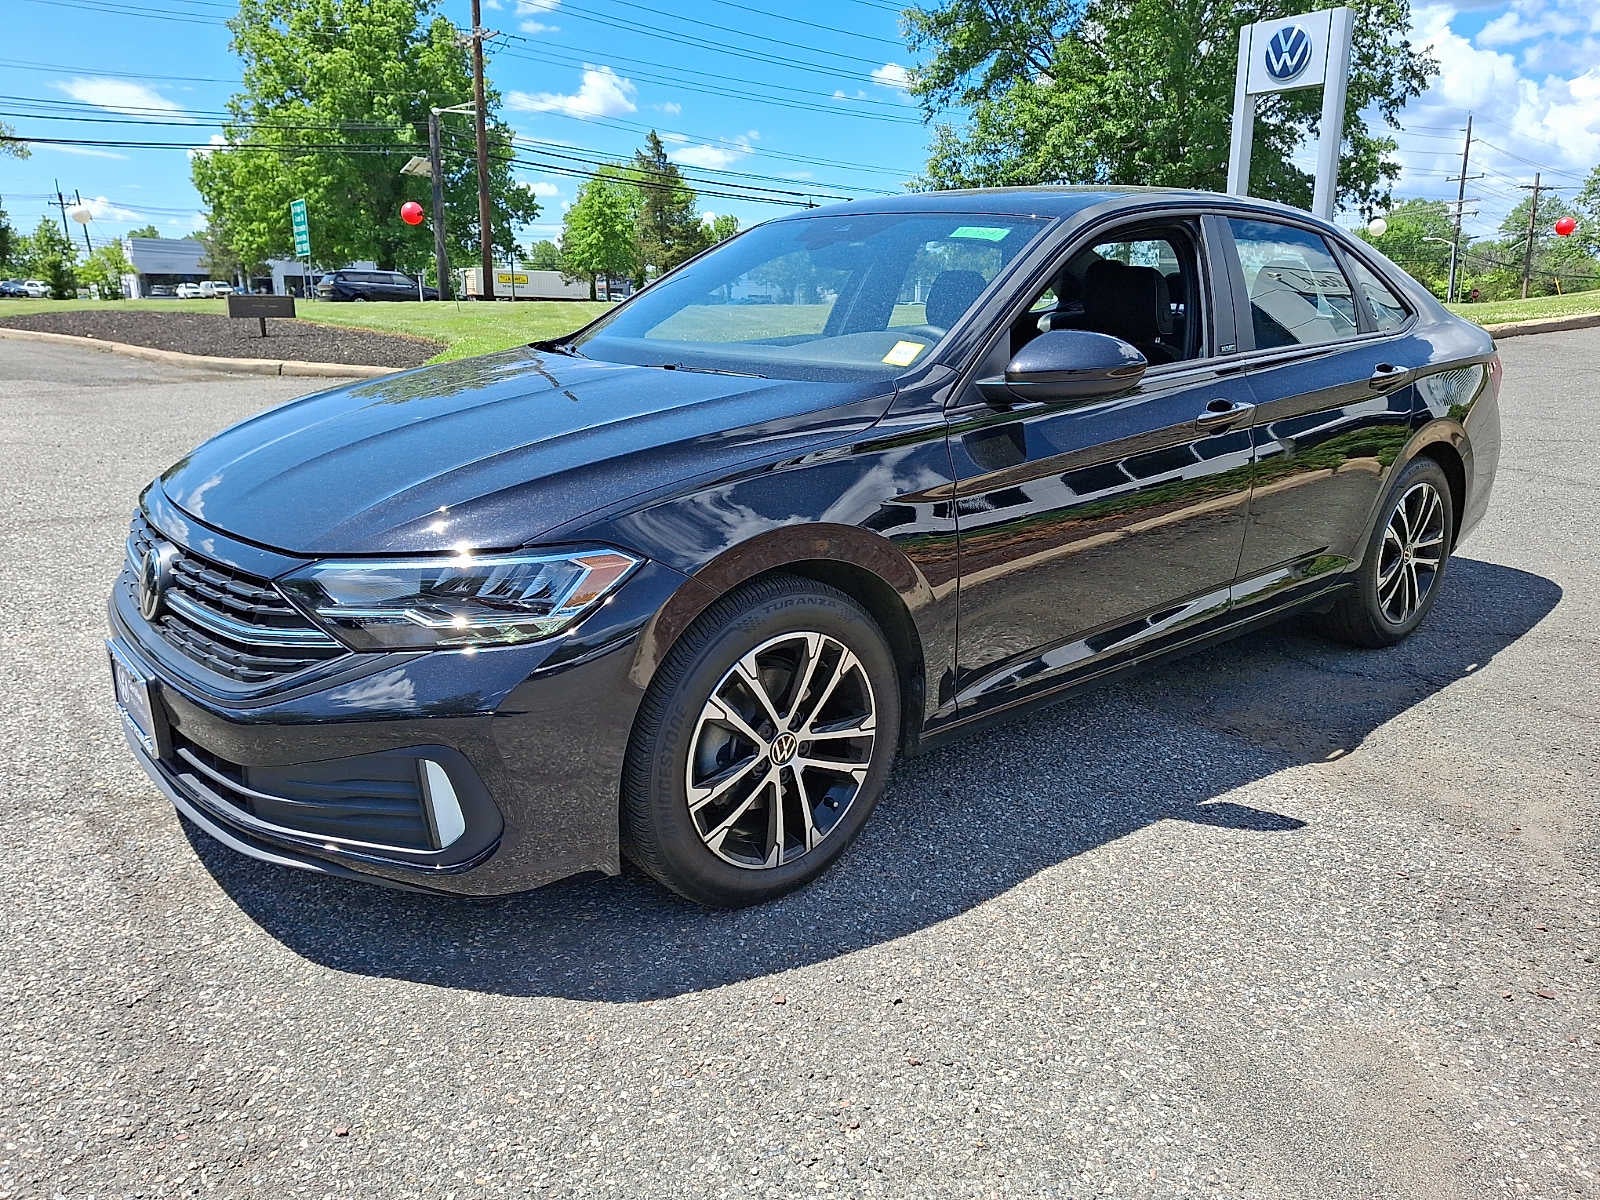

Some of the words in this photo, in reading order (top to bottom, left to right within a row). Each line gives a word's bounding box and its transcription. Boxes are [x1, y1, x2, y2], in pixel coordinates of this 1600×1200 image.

[1265, 23, 1311, 78] VW
[762, 597, 837, 614] TURANZA
[772, 734, 796, 764] VW
